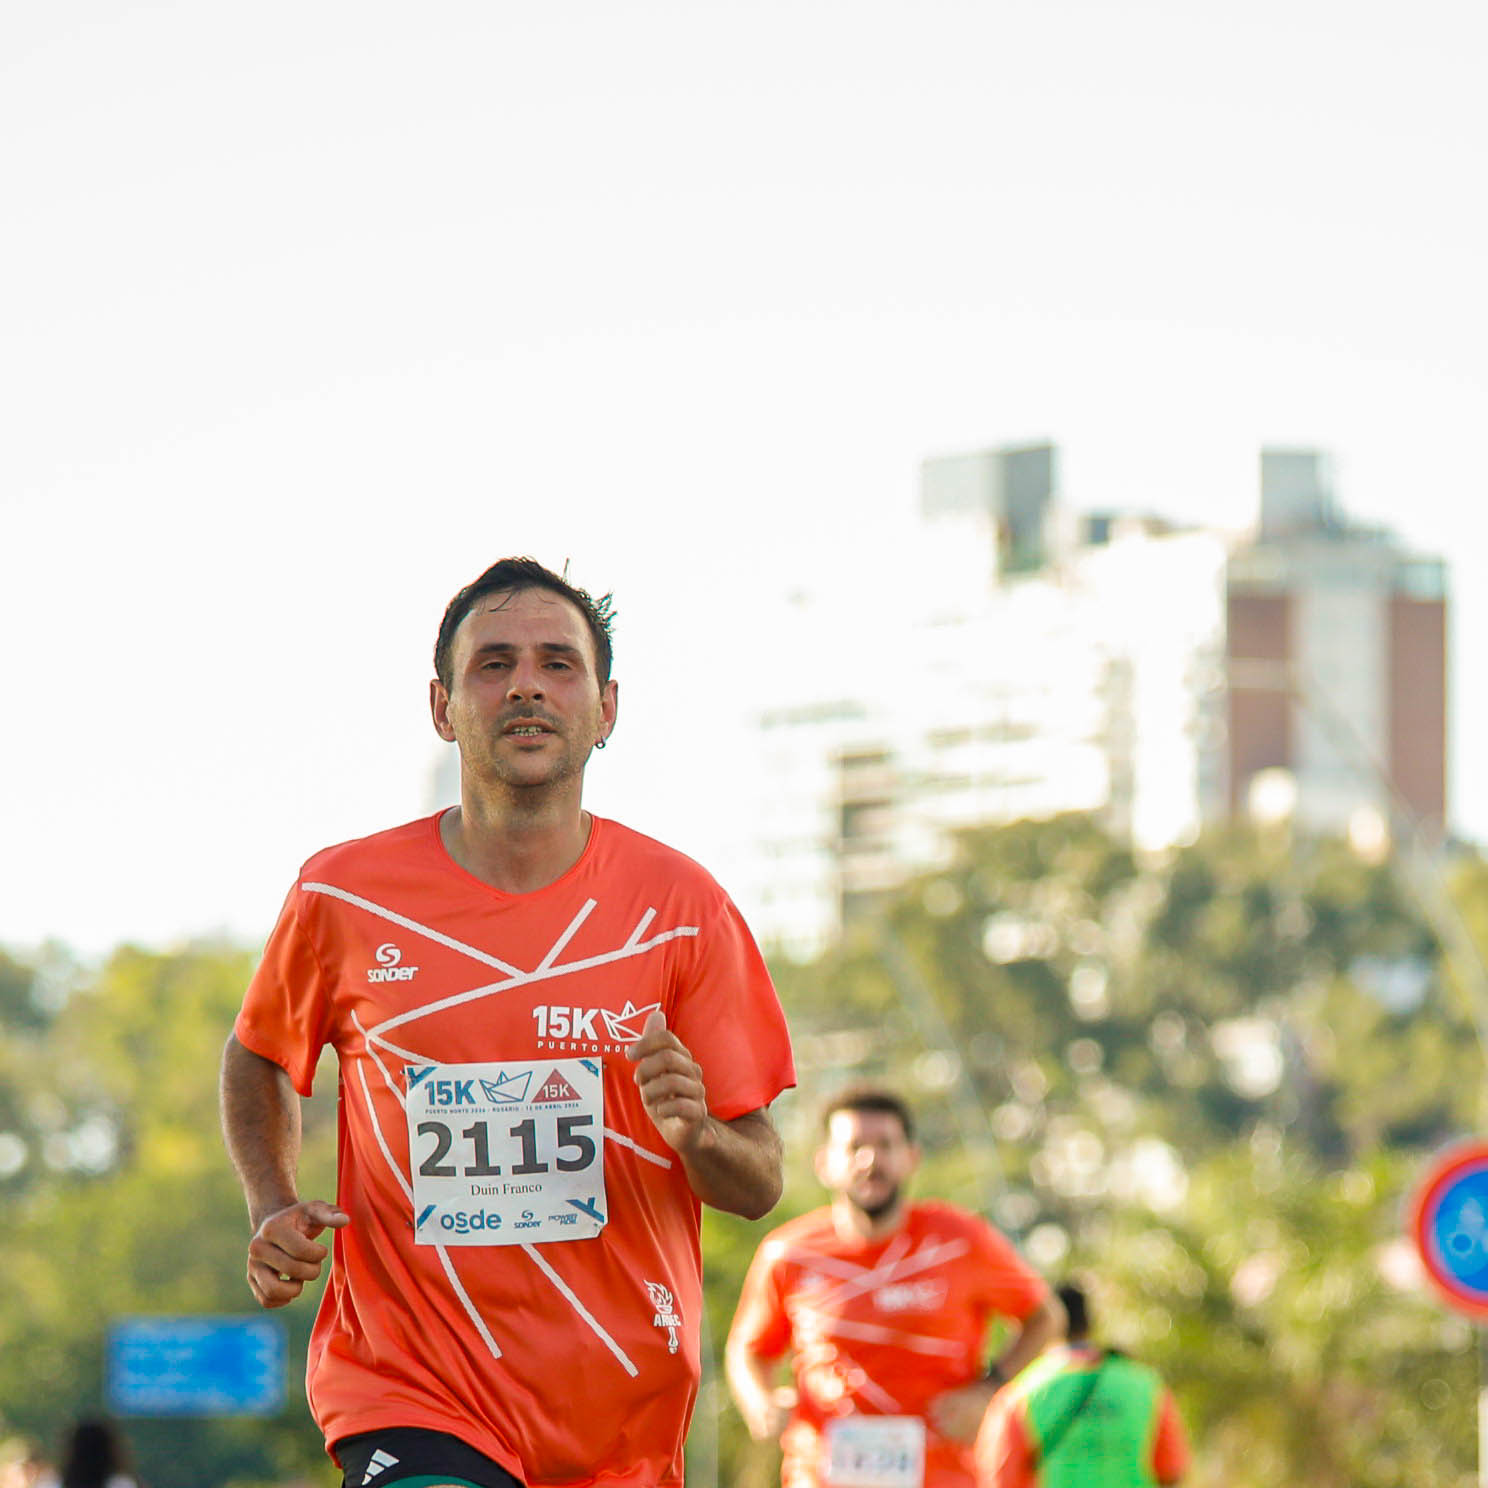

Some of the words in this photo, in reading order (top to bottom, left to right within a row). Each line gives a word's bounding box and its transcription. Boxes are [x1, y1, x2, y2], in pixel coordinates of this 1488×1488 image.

[532, 1005, 599, 1041] 15K
[537, 1041, 598, 1052] PUERTO
[424, 1079, 477, 1106] 15K
[543, 1083, 570, 1099] 15K
[417, 1115, 596, 1176] 2115
[471, 1183, 499, 1196] Duin
[503, 1182, 543, 1195] Franco
[440, 1208, 502, 1232] osde
